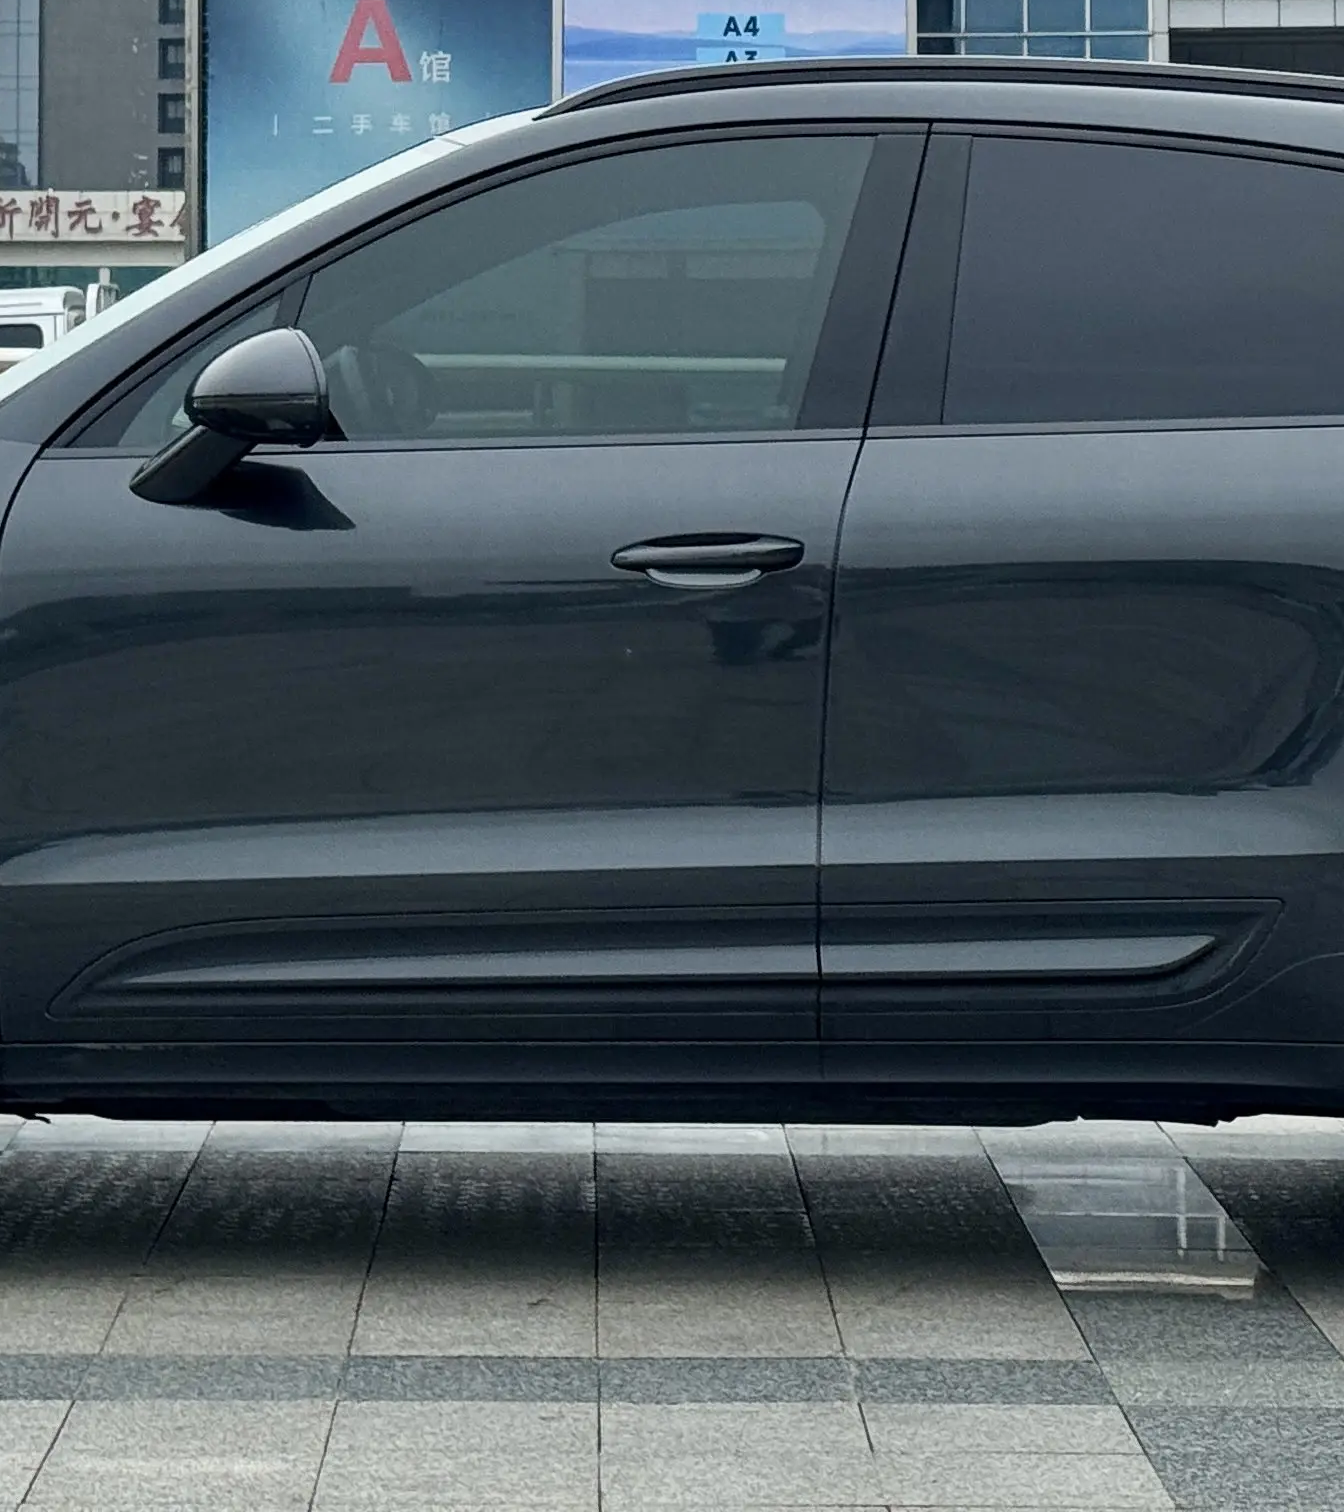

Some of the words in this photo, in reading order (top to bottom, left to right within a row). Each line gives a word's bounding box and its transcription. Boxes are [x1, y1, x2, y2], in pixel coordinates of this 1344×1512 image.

[722, 15, 761, 37] A4
[312, 113, 451, 135] 二手车馆
